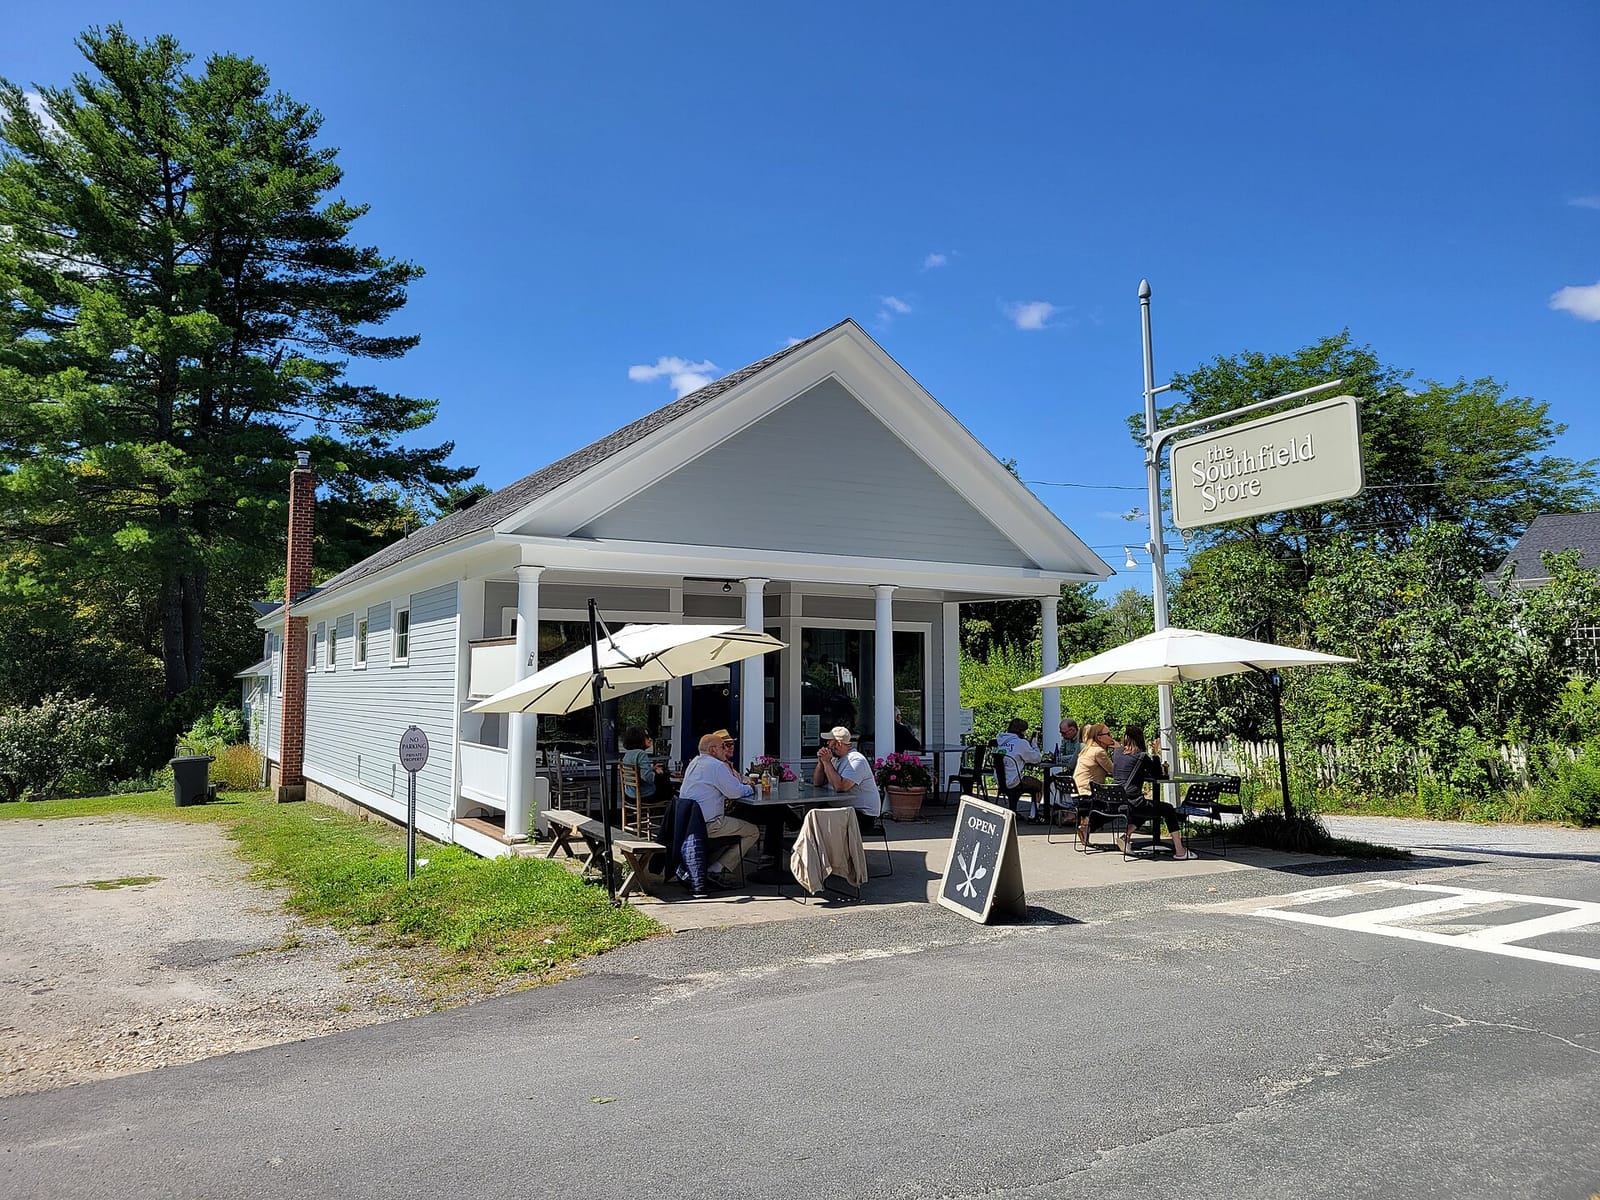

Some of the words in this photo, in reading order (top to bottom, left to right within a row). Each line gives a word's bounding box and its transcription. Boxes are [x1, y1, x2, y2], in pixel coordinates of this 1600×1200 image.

[1191, 434, 1315, 488] Southfield
[1207, 445, 1234, 463] the
[1202, 477, 1261, 512] Store
[968, 816, 997, 836] OPEN
